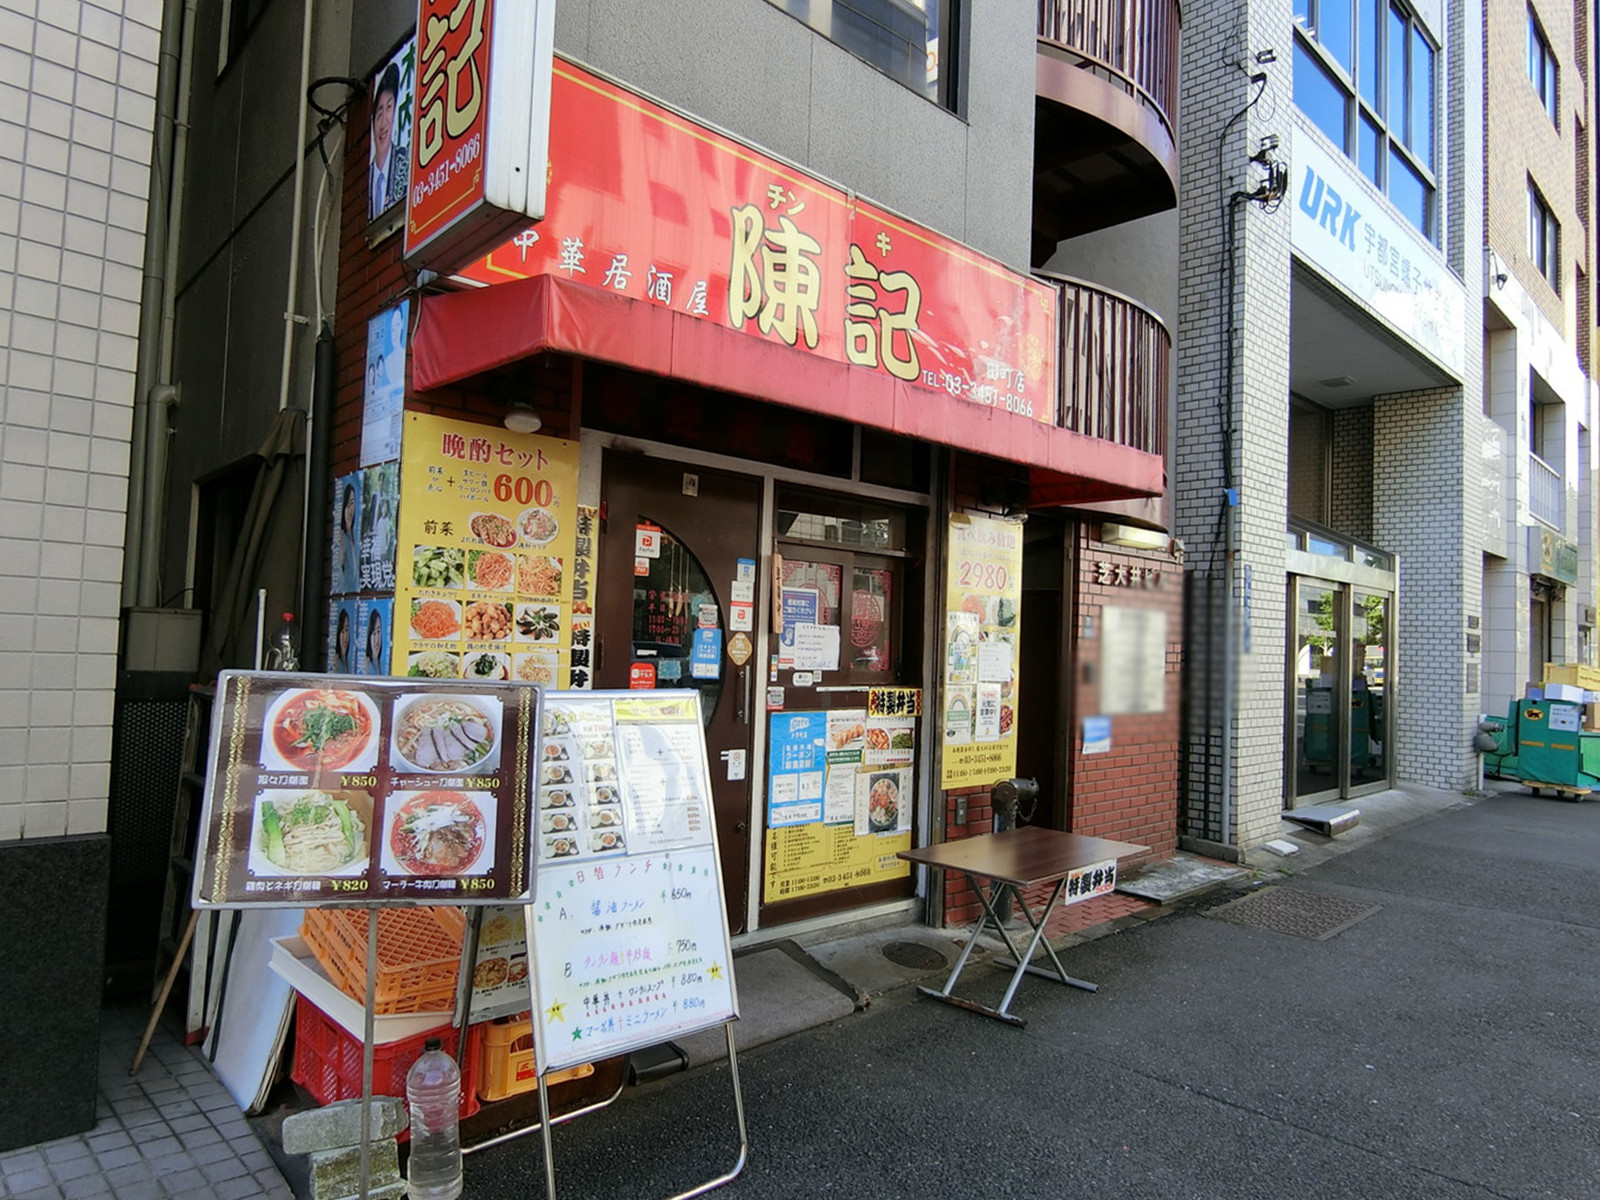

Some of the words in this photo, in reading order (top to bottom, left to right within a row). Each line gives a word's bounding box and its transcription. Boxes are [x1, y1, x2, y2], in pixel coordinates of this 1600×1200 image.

[410, 132, 481, 208] 03-3451-8066
[767, 183, 805, 216] チン
[1298, 165, 1363, 253] URK
[877, 231, 892, 257] キ
[513, 230, 710, 316] 中華居酒屋
[728, 204, 921, 382] 陳記
[442, 432, 549, 471] 晩酌セット
[494, 473, 553, 507] 600
[424, 520, 454, 537] 前菜
[959, 560, 1007, 590] 2980
[877, 690, 915, 715] 特製弁当
[786, 751, 812, 760] クーポン
[340, 776, 377, 787] ¥850
[466, 778, 500, 789] ¥850
[576, 859, 652, 883] 日替ランチ
[330, 880, 369, 891] ¥820
[460, 879, 495, 890] ¥850
